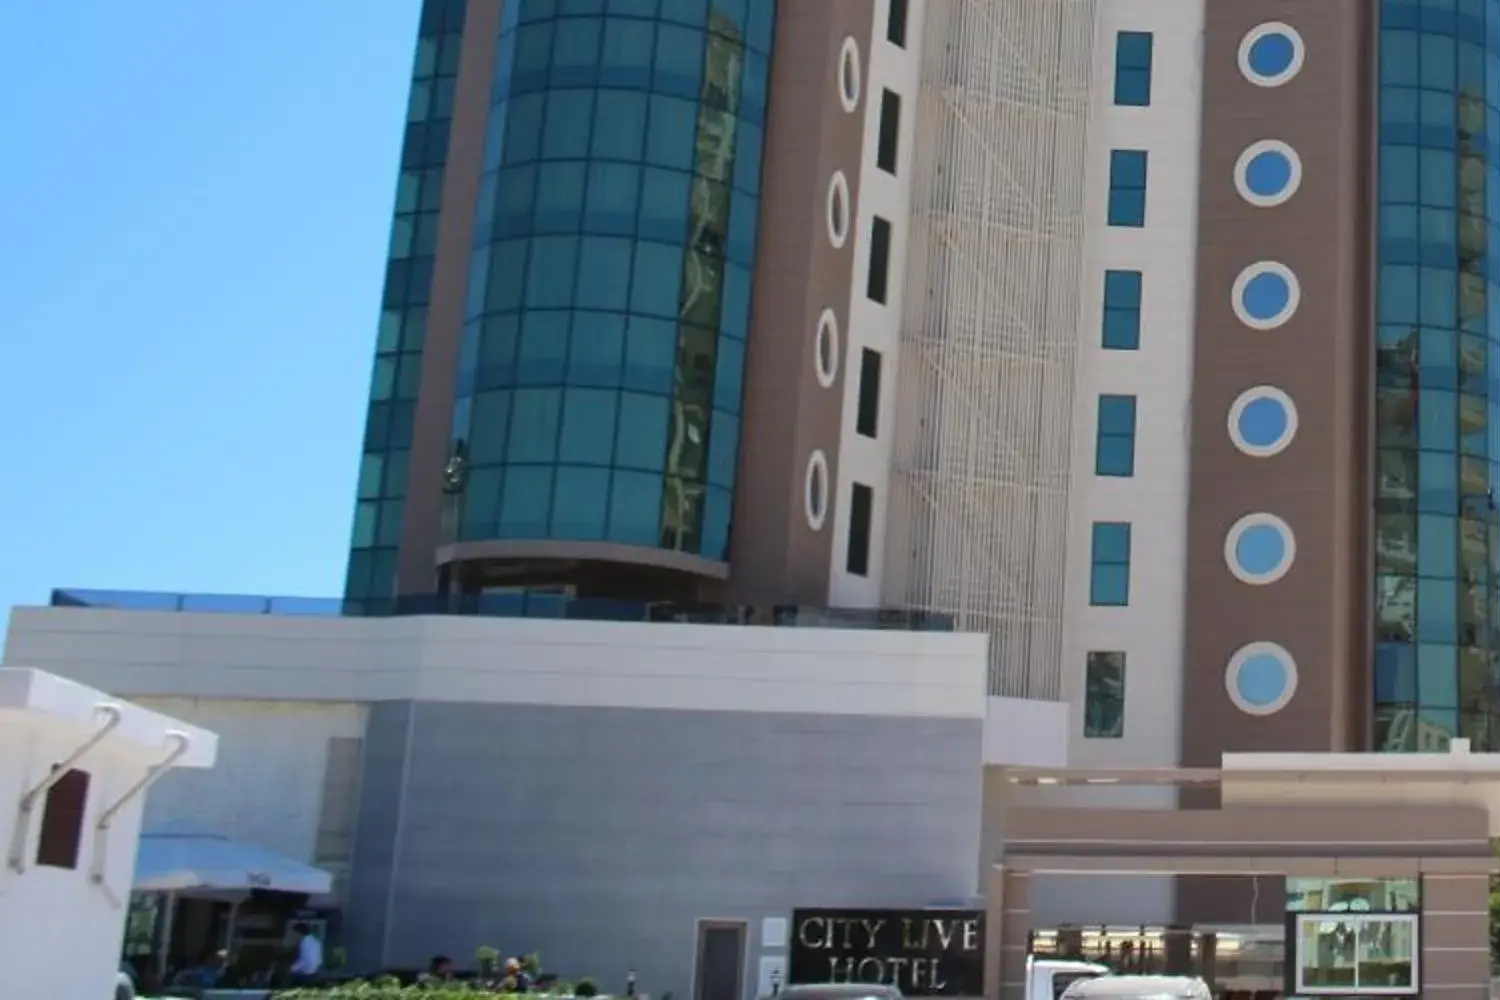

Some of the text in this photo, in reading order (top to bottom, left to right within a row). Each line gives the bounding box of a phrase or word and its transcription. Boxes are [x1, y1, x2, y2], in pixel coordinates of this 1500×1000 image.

[799, 916, 978, 950] CITY LIVE
[828, 956, 946, 989] HOTEL
